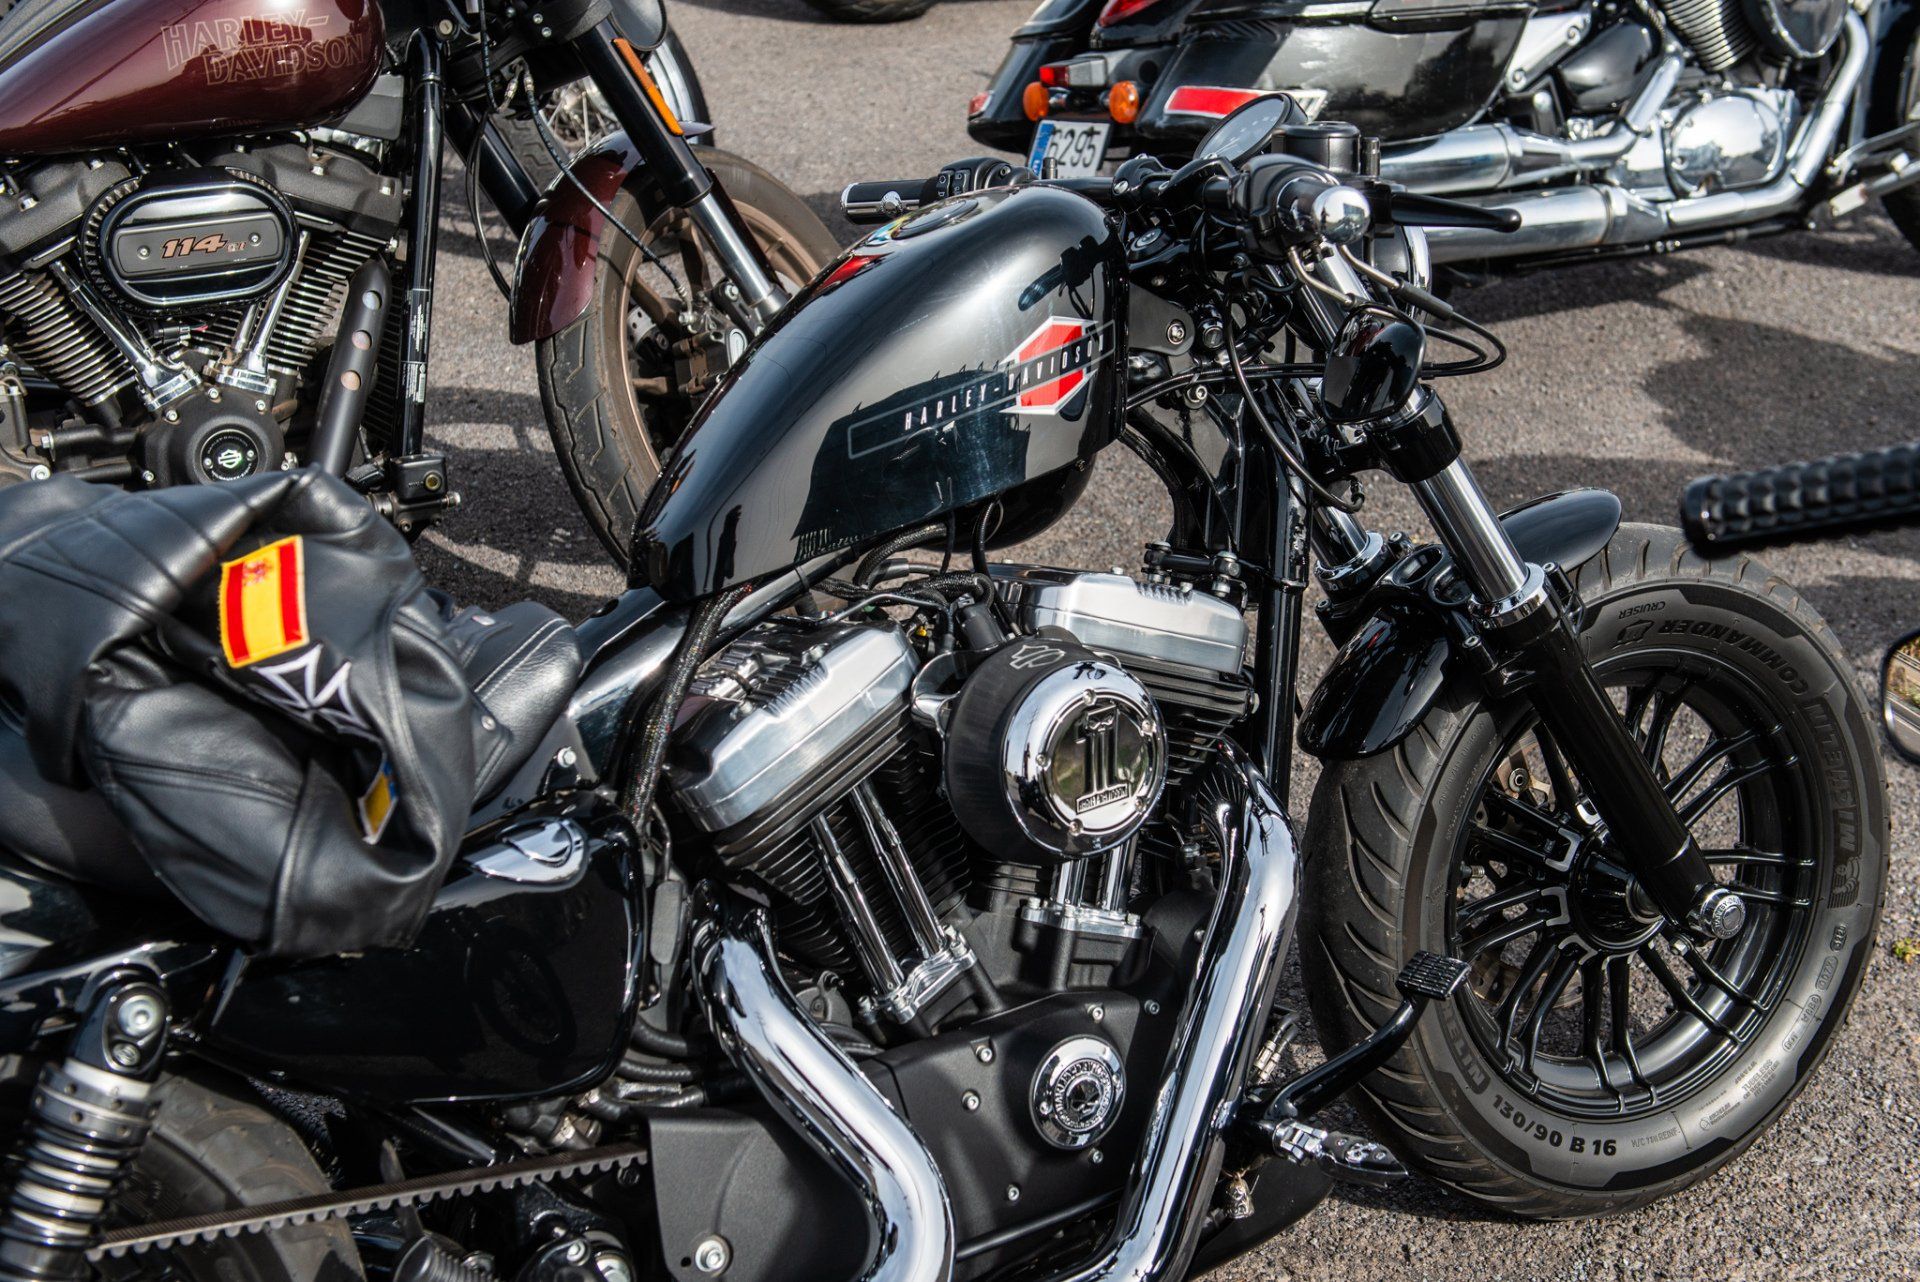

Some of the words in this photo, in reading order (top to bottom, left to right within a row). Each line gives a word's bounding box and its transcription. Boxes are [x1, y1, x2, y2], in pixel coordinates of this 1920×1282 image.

[160, 9, 330, 71] HARLEY-
[203, 33, 365, 86] DAVIDSON
[1047, 126, 1102, 168] 6295
[161, 232, 229, 260] 114
[903, 333, 1105, 431] HARLEY-DAVIDSON
[1617, 600, 1666, 620] CRUISER
[1655, 618, 1810, 697] COMMANDER
[1803, 702, 1858, 854] MICHELIN
[1491, 1094, 1564, 1148] 130/90
[1569, 1135, 1586, 1154] B
[1592, 1139, 1618, 1157] 16
